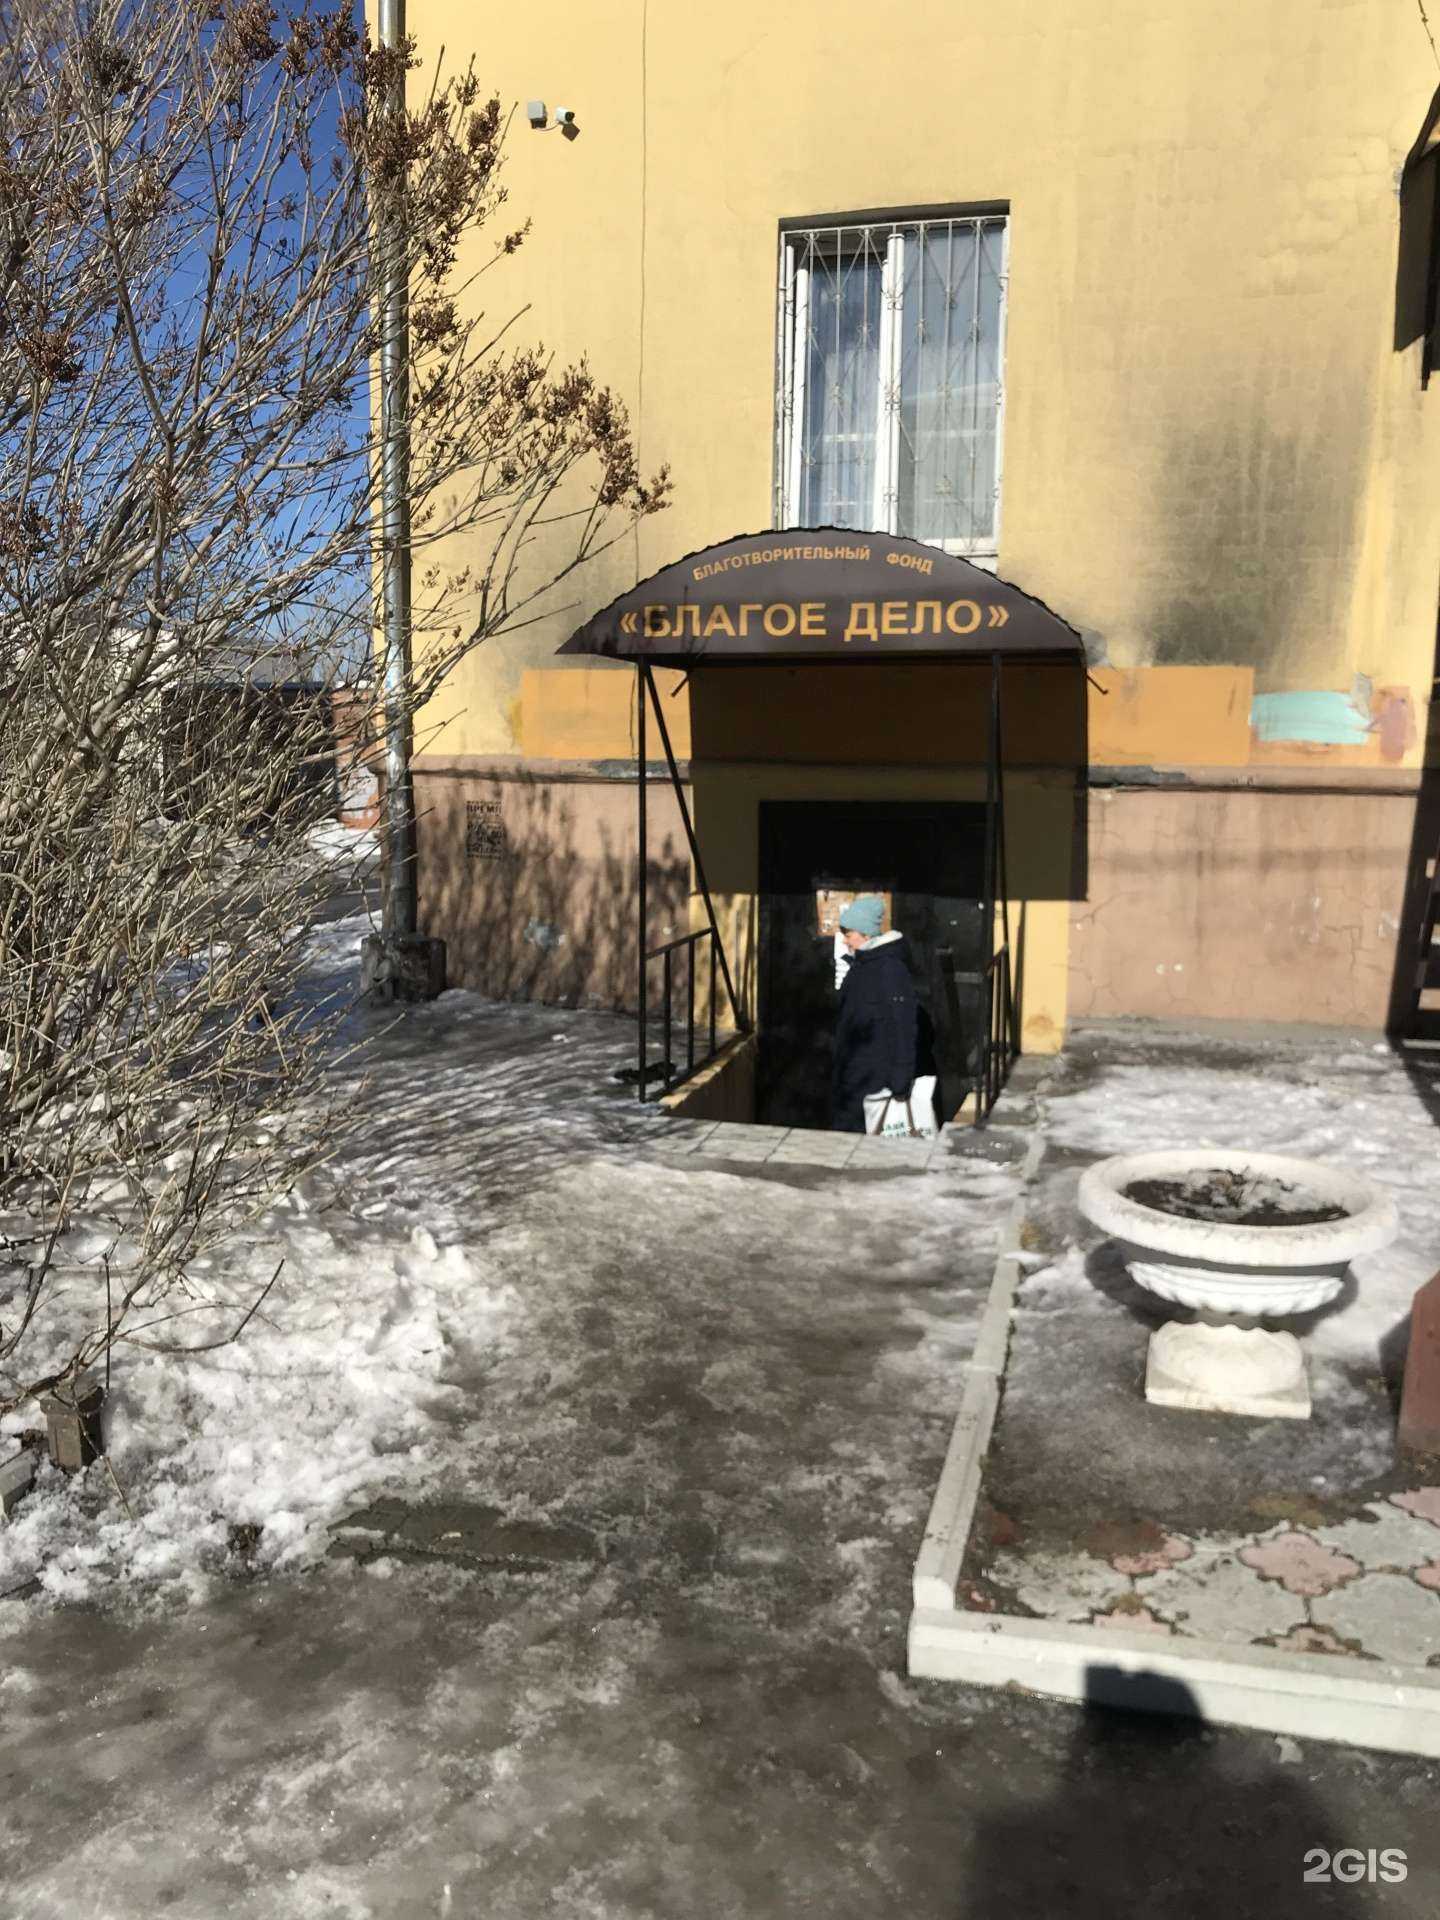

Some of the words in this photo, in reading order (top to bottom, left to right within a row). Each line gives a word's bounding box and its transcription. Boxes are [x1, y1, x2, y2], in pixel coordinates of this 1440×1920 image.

[692, 545, 871, 581] БЛАГОТВОРИТЕЛЬНЫЙ
[886, 552, 934, 575] ФОНД
[620, 602, 827, 638] «БЛАГОЕ
[843, 599, 1009, 642] ДЕЛО»
